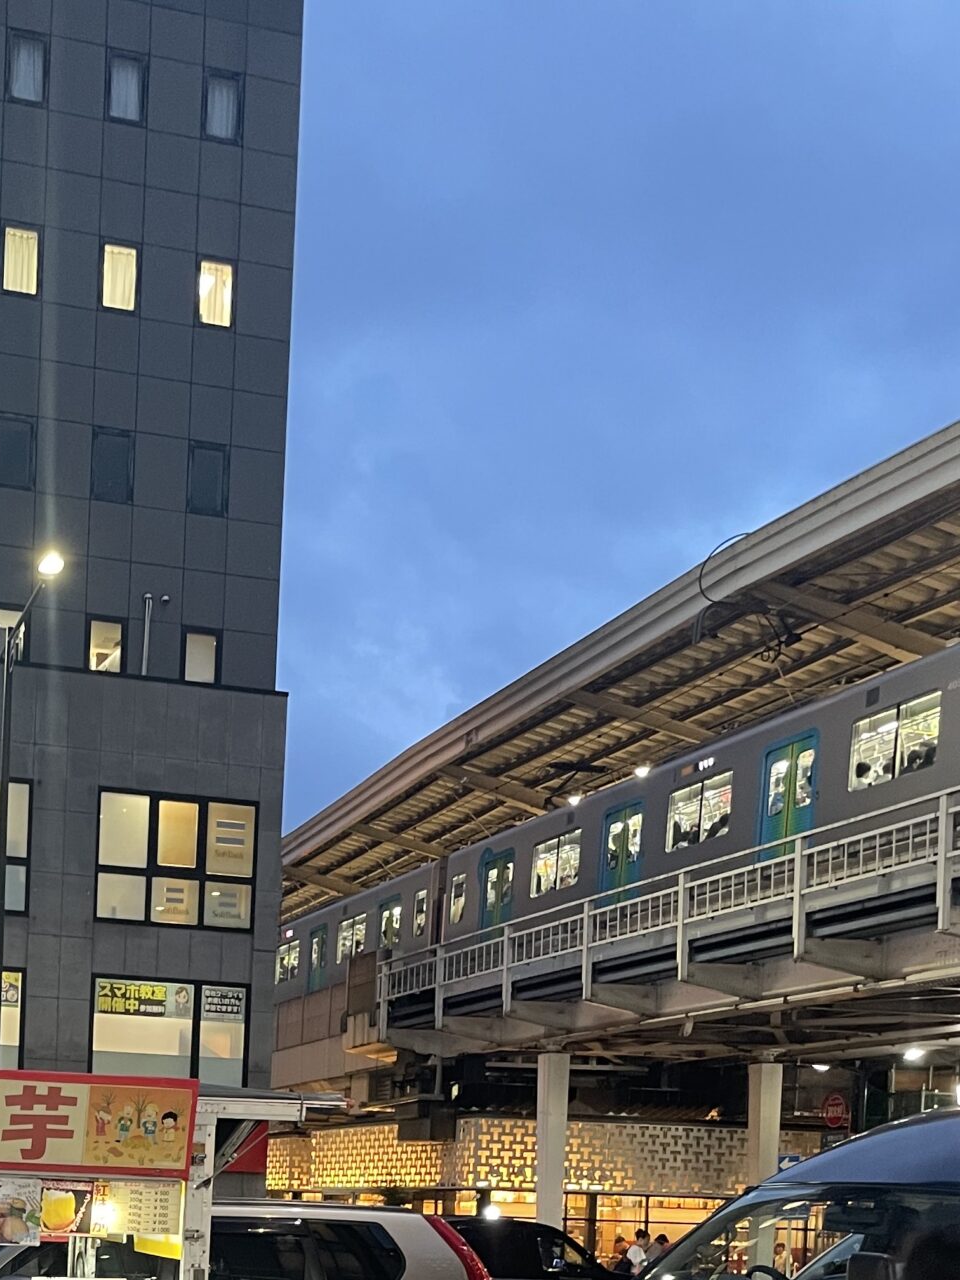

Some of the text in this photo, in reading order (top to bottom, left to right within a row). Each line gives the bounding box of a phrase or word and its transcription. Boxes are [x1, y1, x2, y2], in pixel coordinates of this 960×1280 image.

[99, 982, 167, 1000] スマホ教室
[98, 997, 139, 1013] 開催中
